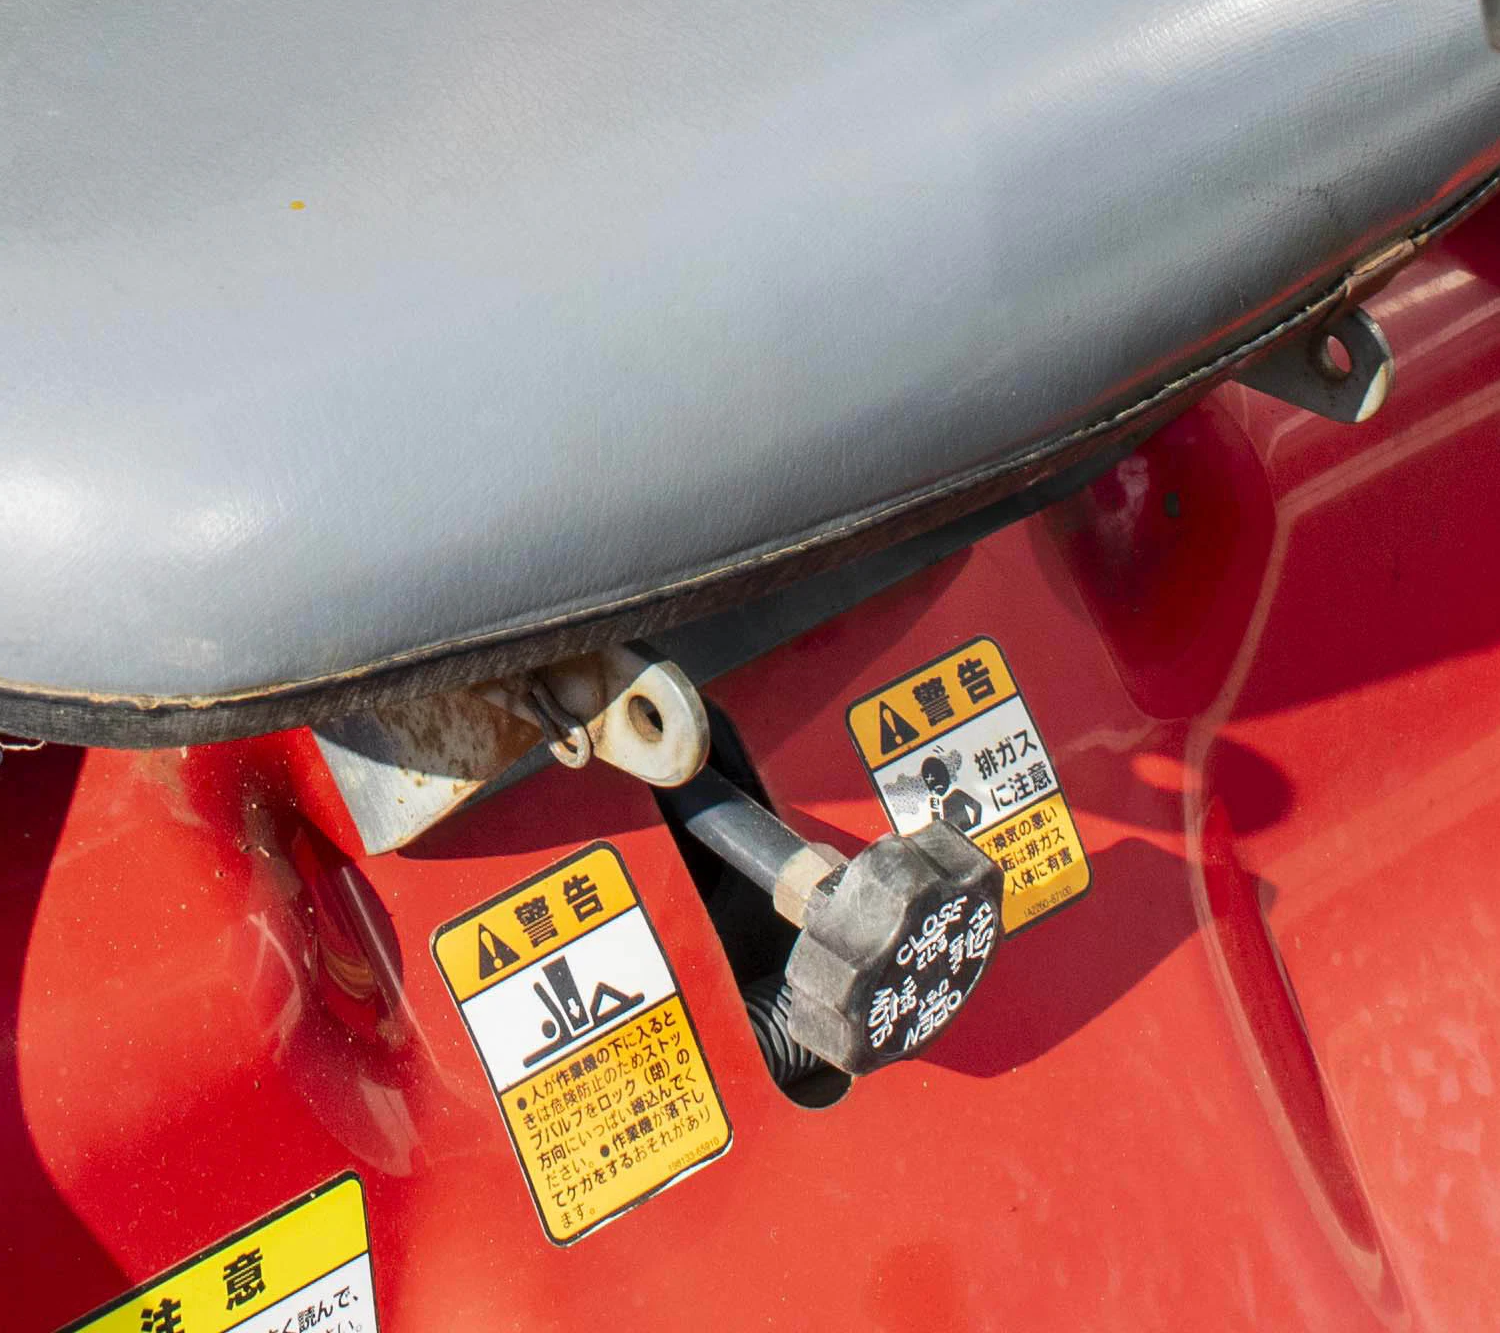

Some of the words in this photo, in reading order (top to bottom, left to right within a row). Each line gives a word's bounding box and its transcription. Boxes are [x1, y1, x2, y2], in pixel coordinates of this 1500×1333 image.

[912, 657, 996, 728] 警告
[973, 729, 1038, 781] 排ガス
[989, 760, 1053, 812] に注意
[998, 827, 1065, 873] 転は排ガス
[1010, 846, 1074, 897] 人体に有害
[513, 873, 605, 949] 警告
[895, 895, 969, 966] CLOSE
[903, 989, 963, 1052] OPEN
[522, 1031, 682, 1131] きは危険防止のためストッ
[530, 1009, 677, 1106] 人が作業機の下に入ると
[536, 1067, 698, 1172] 方向にいっぱい締込んでく
[544, 1155, 596, 1190] ださい。
[610, 1089, 706, 1152] 作業機が落下し
[551, 1106, 712, 1209] てケガをするおそれがあり
[560, 1202, 596, 1230] ます。
[140, 1246, 267, 1333] 注意
